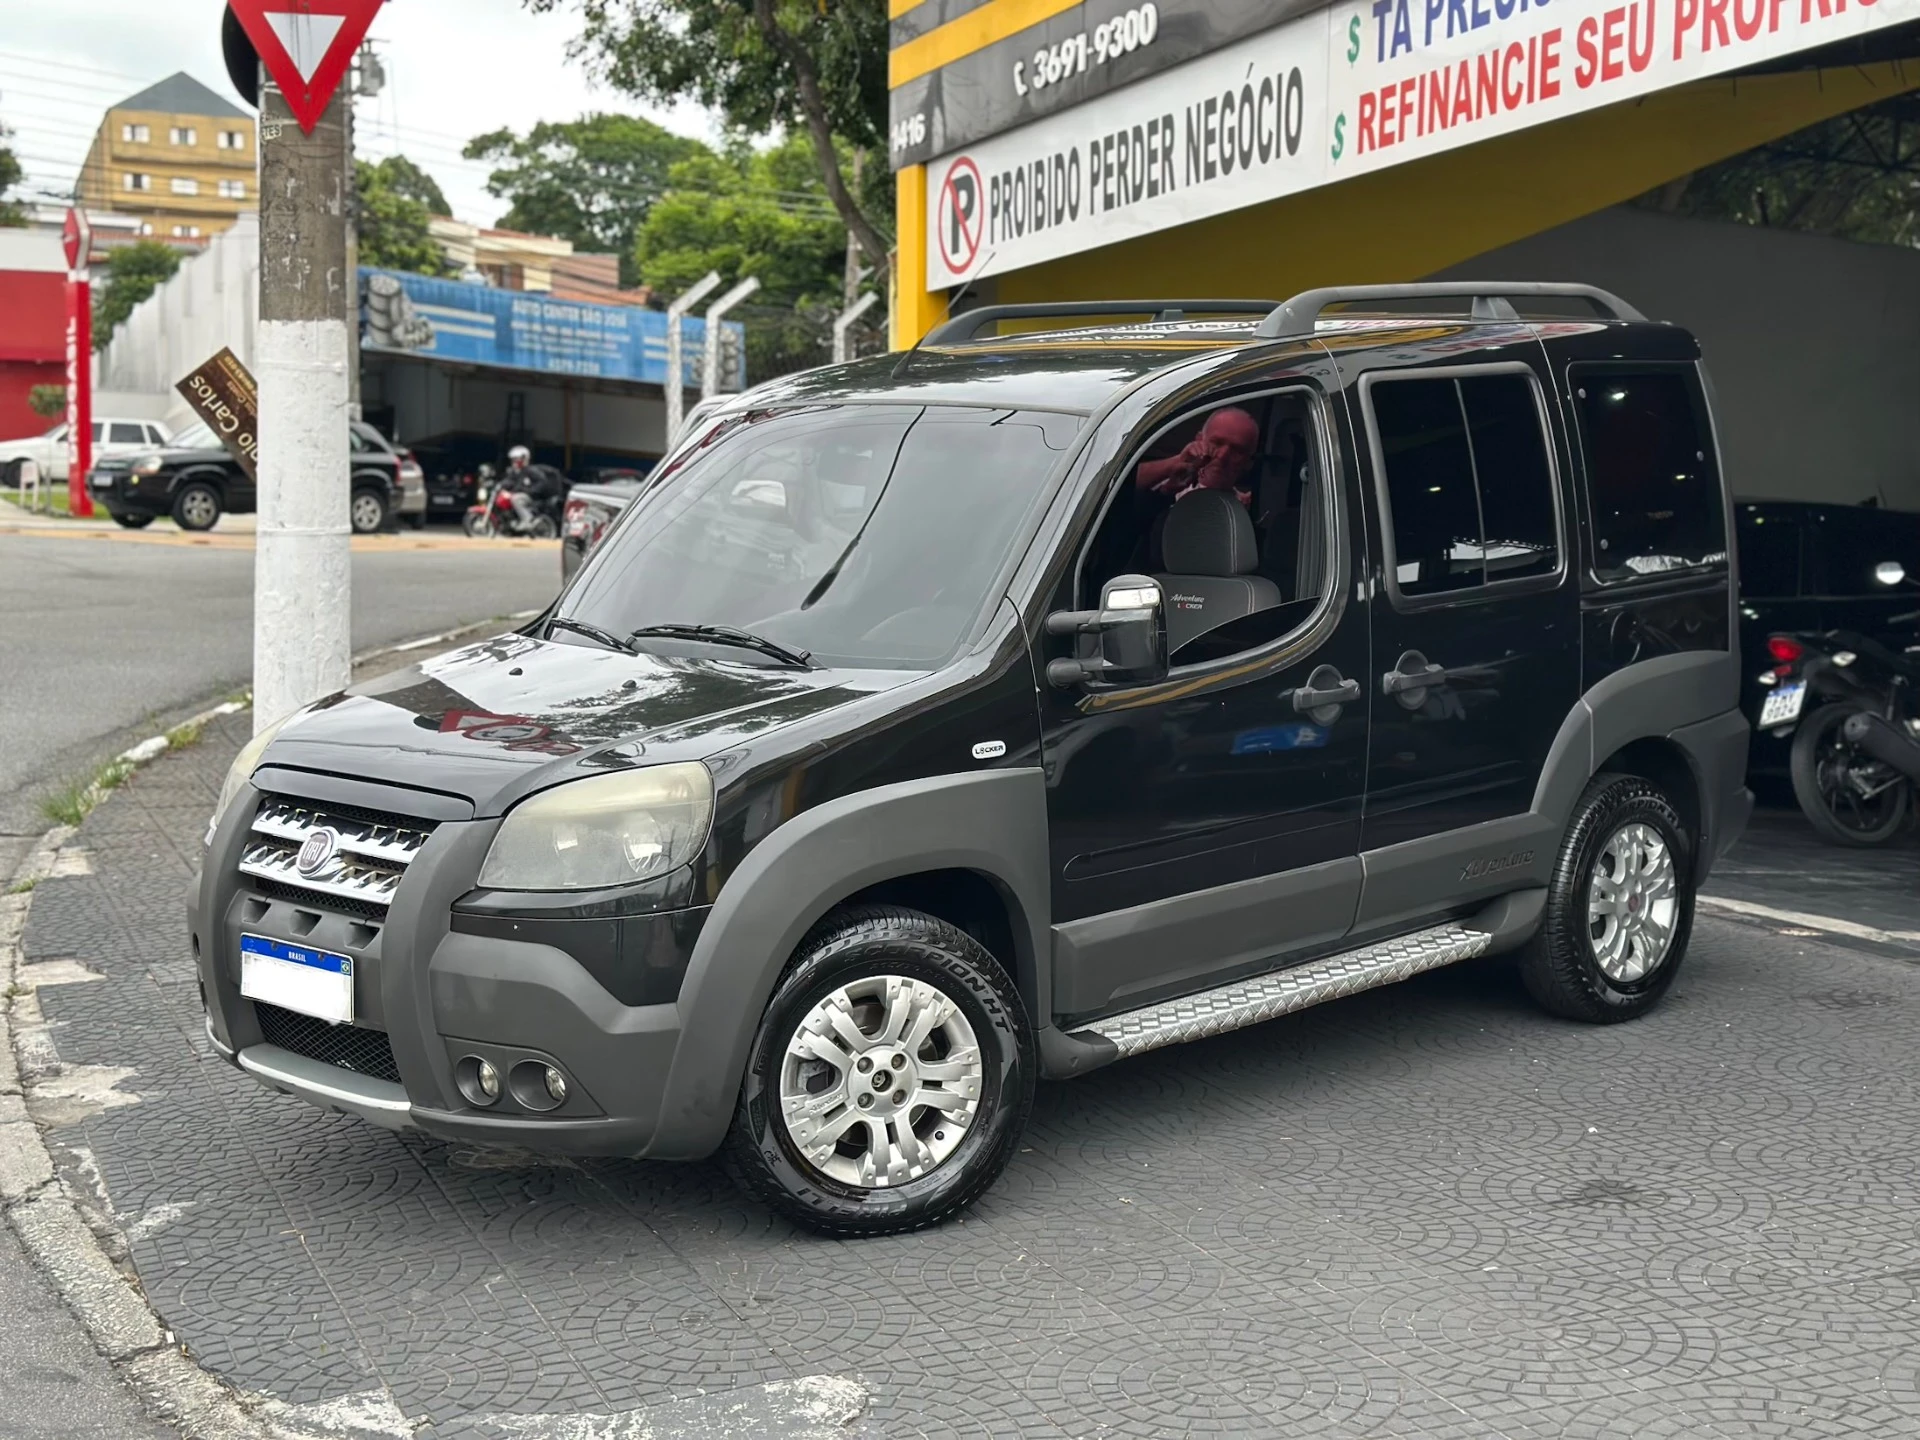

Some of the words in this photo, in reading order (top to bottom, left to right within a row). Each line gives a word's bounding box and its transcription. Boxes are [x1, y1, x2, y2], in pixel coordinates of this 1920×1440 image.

[1032, 3, 1158, 89] 3691-9300
[1357, 27, 1562, 155] REFINANCIE
[1574, 1, 1655, 89] SEU
[990, 146, 1081, 245] PROIBIDO
[1090, 113, 1176, 215] PERDER
[1186, 62, 1303, 187] NEGÓCIO
[189, 375, 239, 433] Carlos
[303, 841, 325, 861] FIAT
[288, 951, 307, 963] BRASIL
